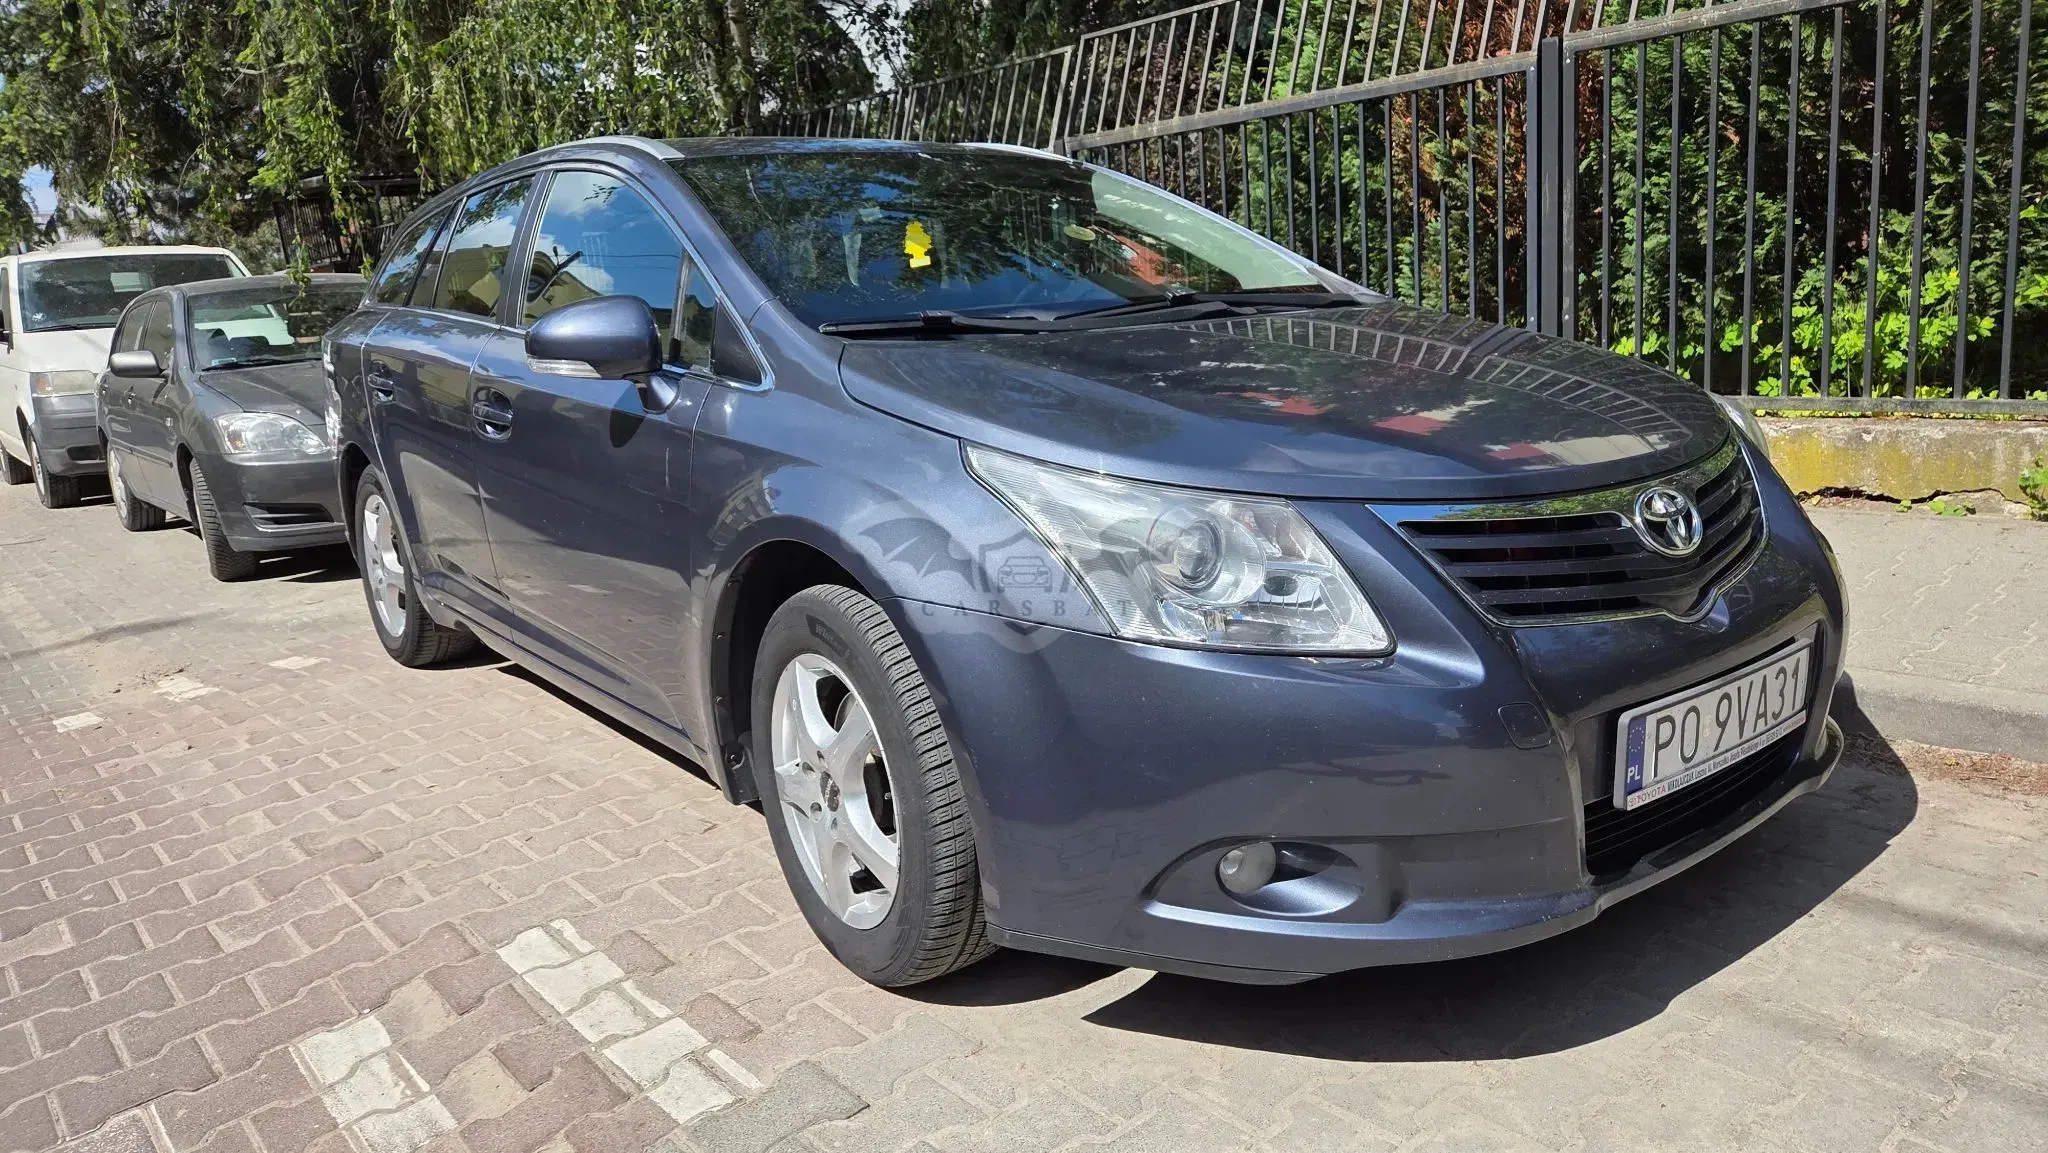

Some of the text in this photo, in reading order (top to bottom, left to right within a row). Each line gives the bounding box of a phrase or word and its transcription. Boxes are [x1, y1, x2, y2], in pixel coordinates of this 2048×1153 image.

[1653, 657, 1800, 778] PO 9VA31
[1627, 764, 1640, 783] PL
[1637, 785, 1666, 803] TOYOTA
